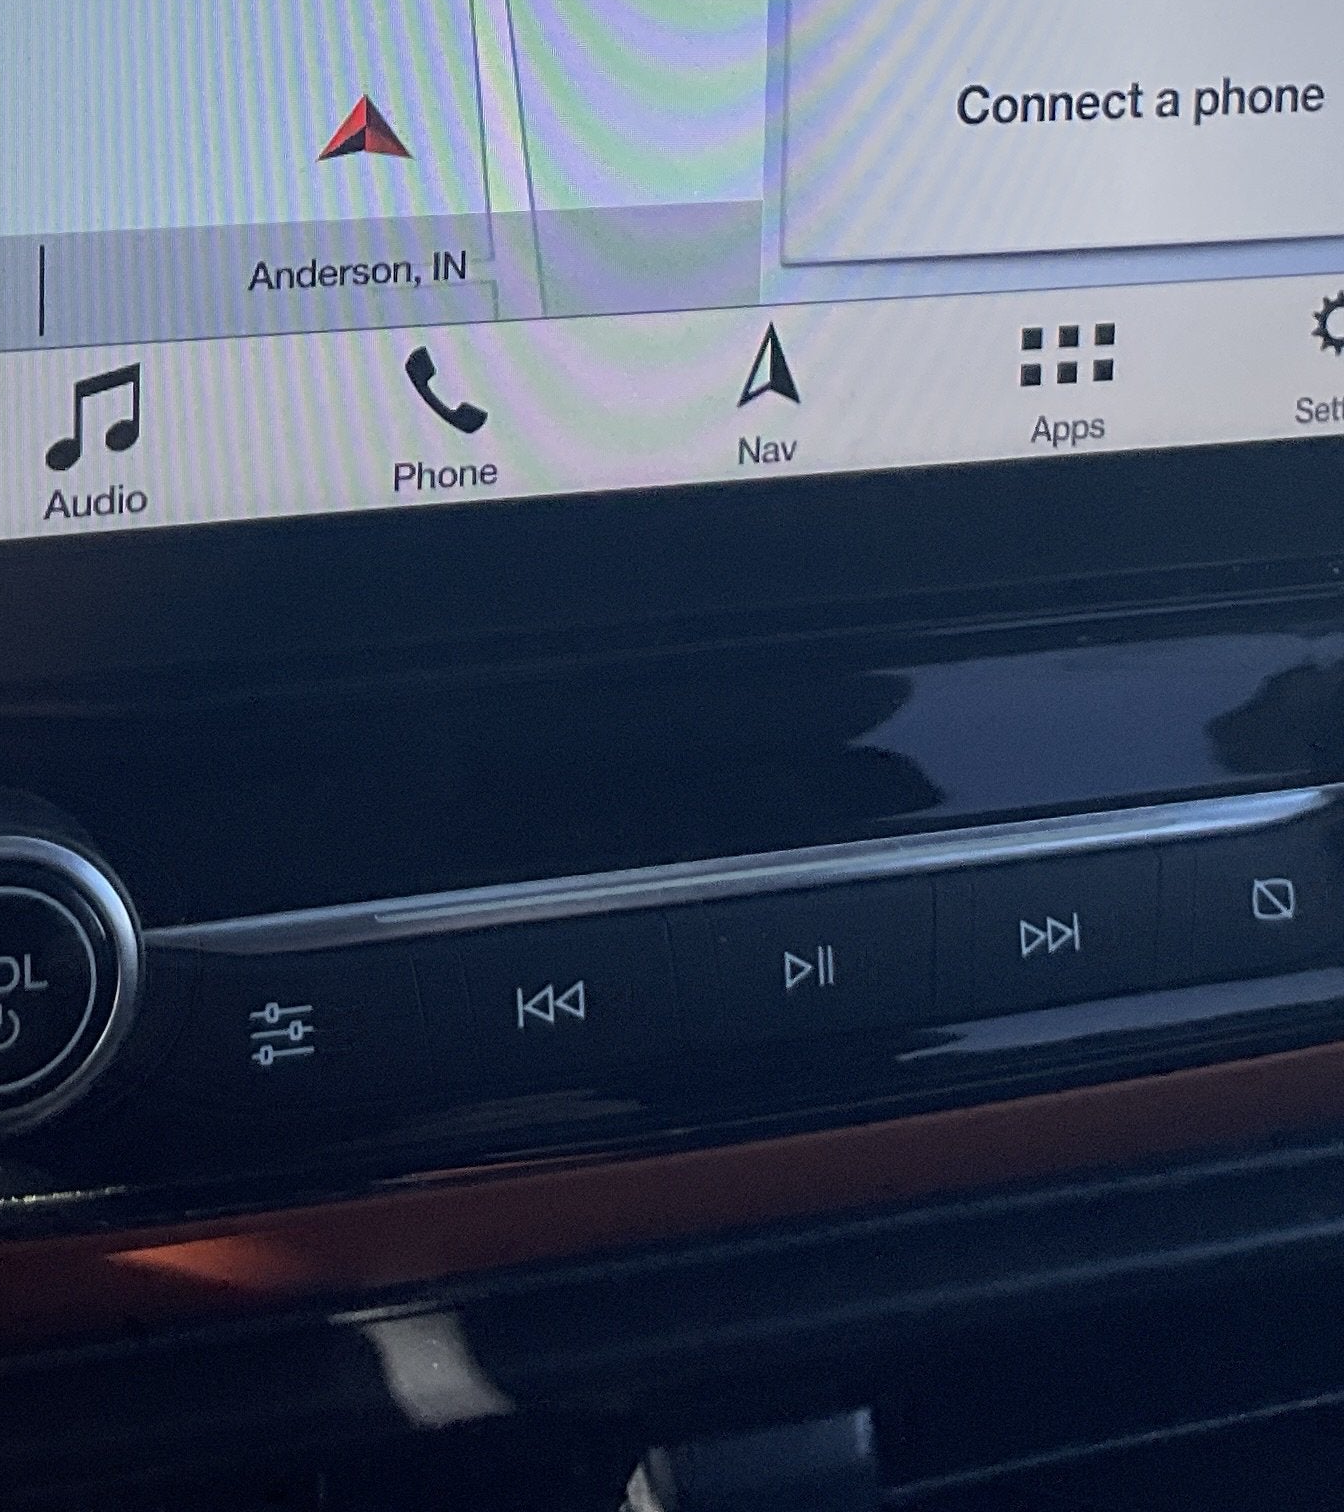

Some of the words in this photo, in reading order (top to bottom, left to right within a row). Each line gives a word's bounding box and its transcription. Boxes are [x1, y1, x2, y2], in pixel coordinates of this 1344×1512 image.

[957, 83, 1143, 125] Connect
[1156, 89, 1180, 118] a
[1194, 77, 1325, 126] phone
[248, 258, 421, 291] Anderson,
[433, 250, 466, 281] IN
[1030, 415, 1105, 448] Apps
[738, 436, 797, 465] Nav
[394, 461, 498, 492] Phone
[43, 484, 148, 520] Audio
